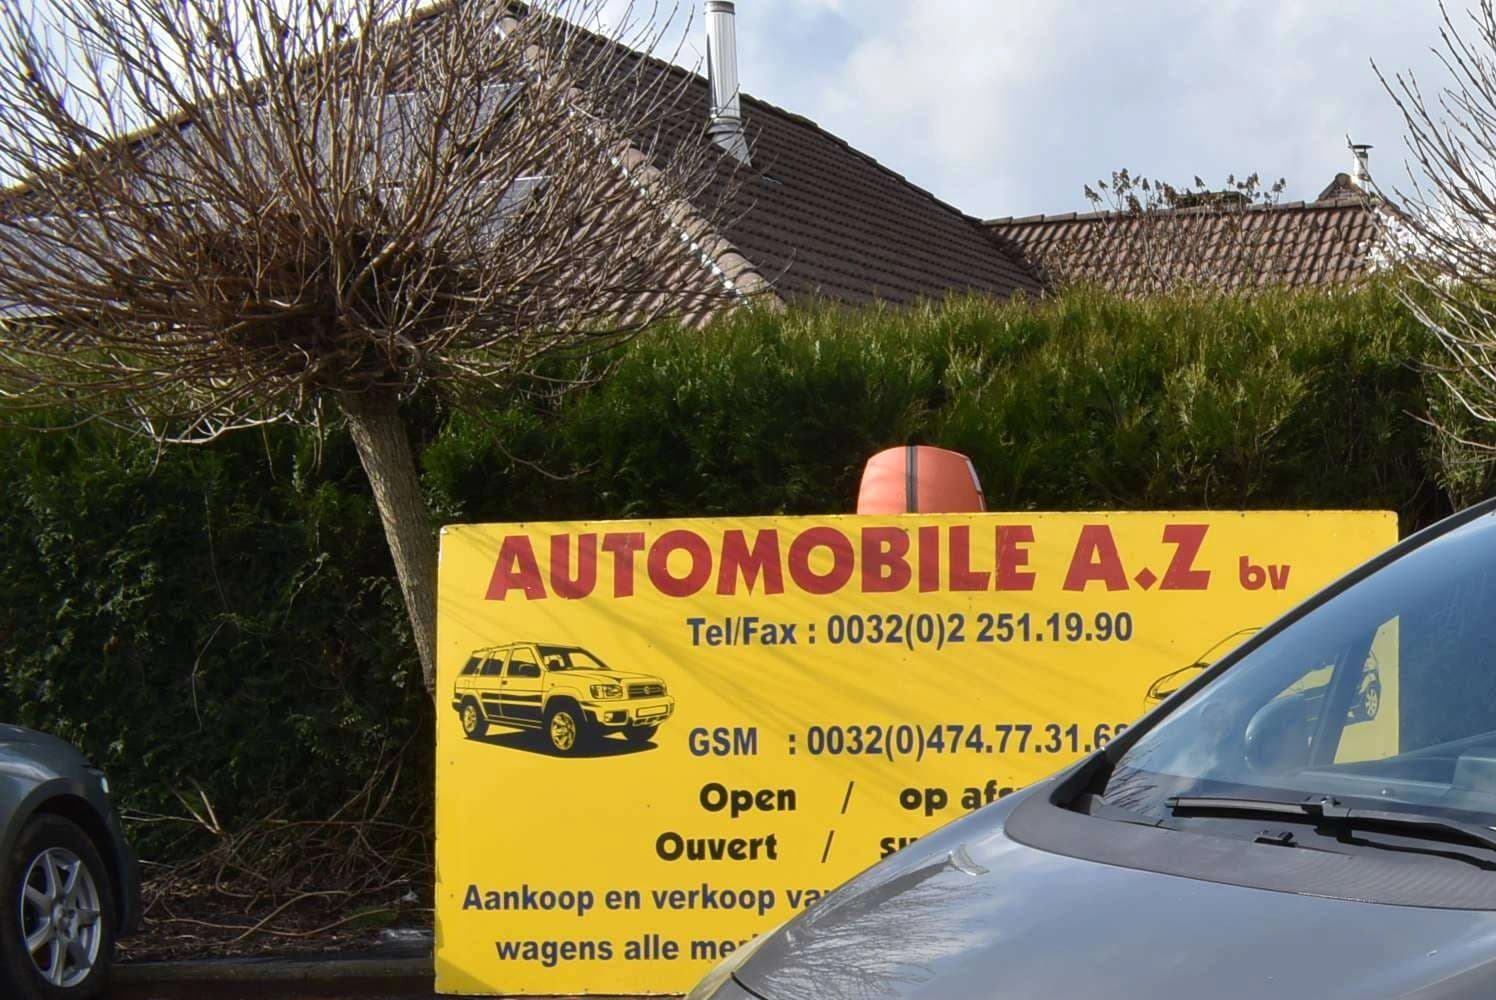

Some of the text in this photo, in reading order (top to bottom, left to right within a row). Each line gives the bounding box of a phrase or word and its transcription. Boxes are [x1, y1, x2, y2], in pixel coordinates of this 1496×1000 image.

[486, 524, 1290, 601] AUTOMOBILE A.Z bv
[687, 616, 797, 647] Tel/Fax
[827, 614, 965, 651] 0032(0)2
[976, 612, 1133, 643] 251.19.90
[689, 727, 757, 757] GSM
[700, 782, 796, 813] Open
[841, 781, 854, 814] /
[900, 787, 948, 816] op
[655, 831, 778, 862] Ouvert
[821, 830, 834, 863] /
[463, 883, 831, 917] Aankoop en verkoop va
[496, 933, 759, 966] wagens alle me
